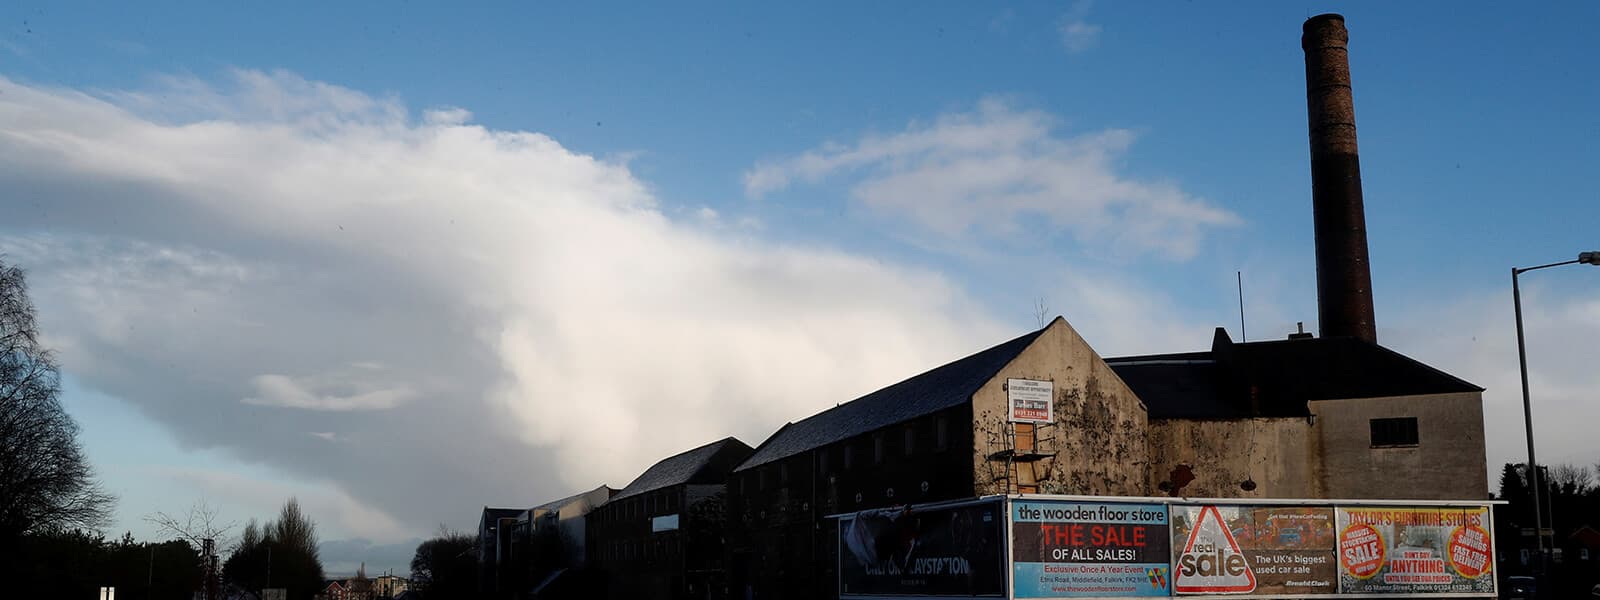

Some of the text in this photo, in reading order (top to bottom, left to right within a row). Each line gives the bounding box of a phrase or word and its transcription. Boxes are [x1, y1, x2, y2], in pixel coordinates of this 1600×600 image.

[1018, 506, 1164, 521] the wooden floor store
[1348, 511, 1481, 526] TAYLOR'S FURNITURE STORES
[1040, 525, 1147, 546] THE SALE
[1466, 528, 1484, 541] HUGE
[1194, 542, 1216, 553] real
[1458, 535, 1487, 552] SAVINGS
[1052, 549, 1136, 561] OF ALL SALES!
[1273, 555, 1293, 563] UK's
[1295, 556, 1326, 564] biggest
[1345, 542, 1380, 566] SALE
[1472, 551, 1487, 562] FREE
[1181, 549, 1246, 577] sale
[1392, 560, 1443, 573] ANYTHING
[1454, 554, 1485, 572] DELIVERY
